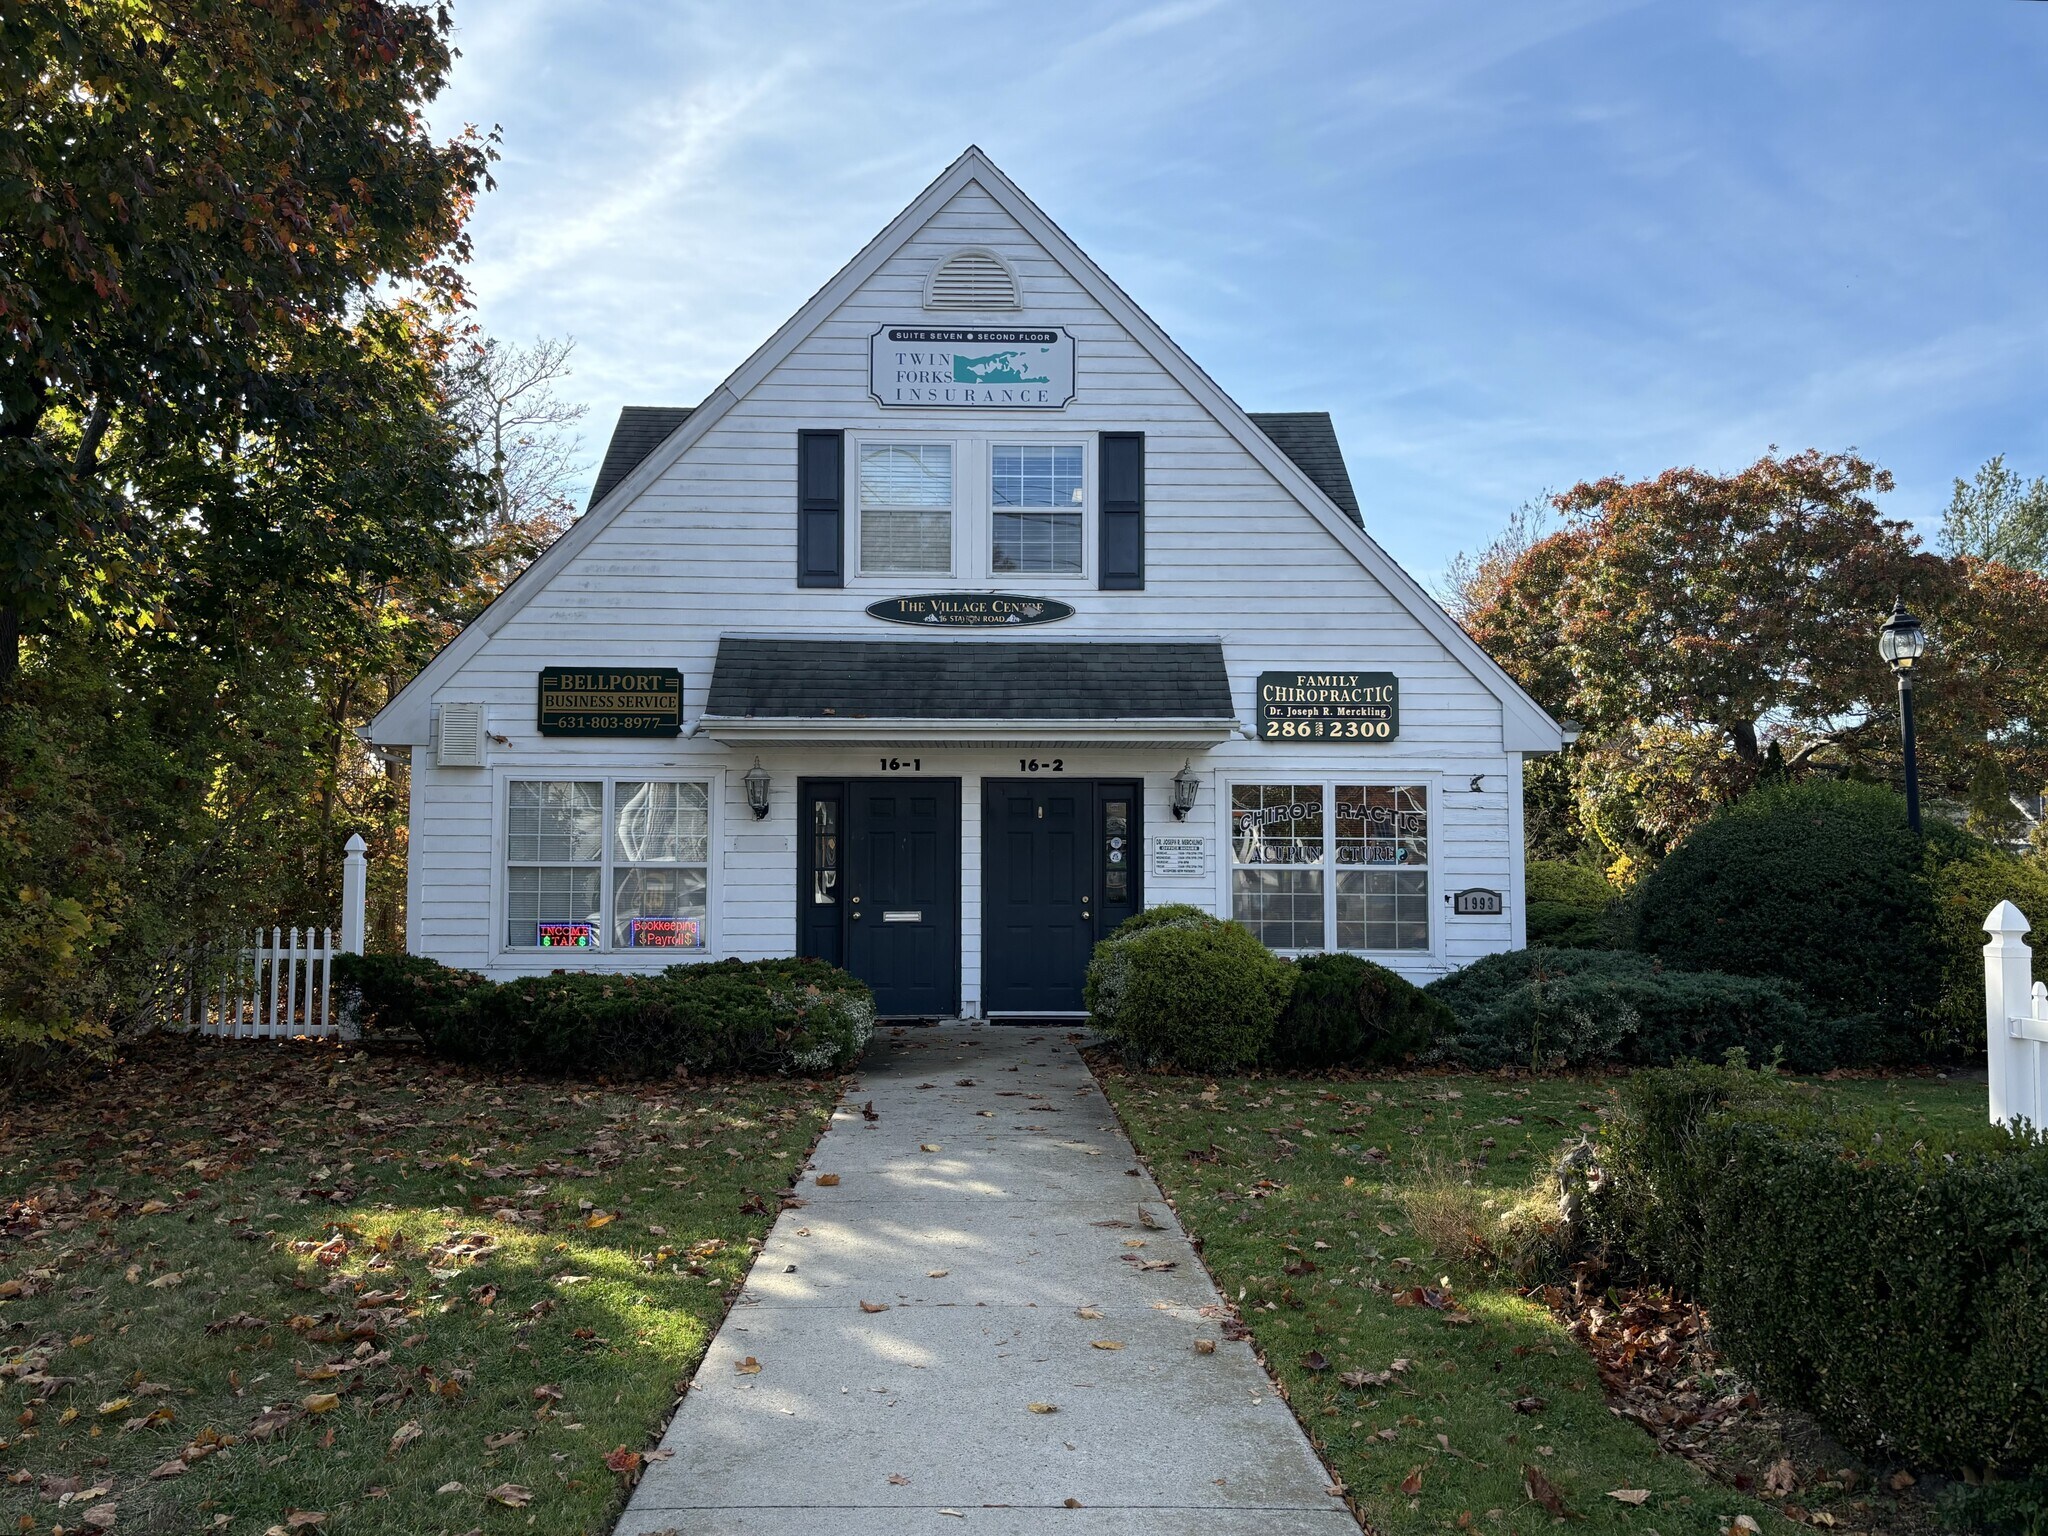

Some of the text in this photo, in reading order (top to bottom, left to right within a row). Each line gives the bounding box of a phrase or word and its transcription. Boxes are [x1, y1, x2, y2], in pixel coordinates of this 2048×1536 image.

[896, 353, 950, 365] TWIN
[896, 371, 952, 383] FORKS
[896, 389, 1048, 402] INSURANCE
[898, 600, 925, 612] THE
[931, 600, 986, 612] VILLAGE
[561, 674, 661, 690] BELLPORT
[1297, 676, 1358, 686] FAMILY
[1263, 685, 1393, 702] CHIROPRACTIC
[545, 695, 676, 708] BUSINESS SERVICE
[1270, 707, 1386, 717] Dr. Joseph R. Merckling
[558, 717, 660, 728] 631-803-8977
[1267, 722, 1390, 738] 286 2300
[880, 758, 920, 771] 16-1
[1020, 759, 1063, 771] 16-2
[1465, 897, 1493, 910] 1993
[541, 927, 588, 936] INCOME
[634, 921, 696, 933] Bookkeeping
